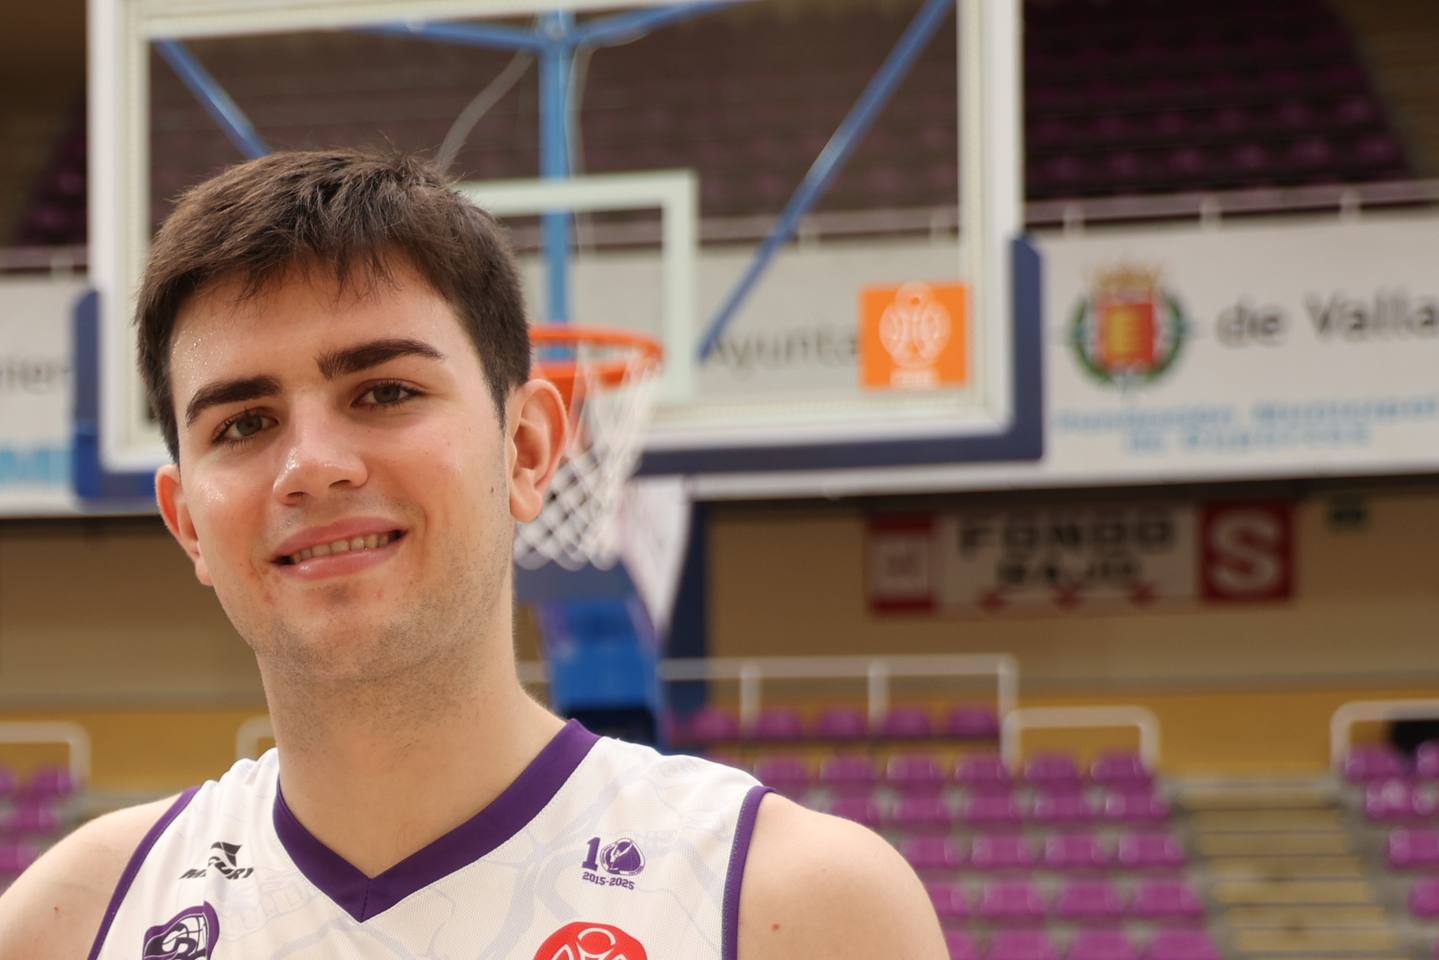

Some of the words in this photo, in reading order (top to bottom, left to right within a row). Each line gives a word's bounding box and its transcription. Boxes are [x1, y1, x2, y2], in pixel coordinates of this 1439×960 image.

[1215, 298, 1289, 348] de
[1208, 510, 1282, 594] S
[582, 871, 636, 890] 2015-2025
